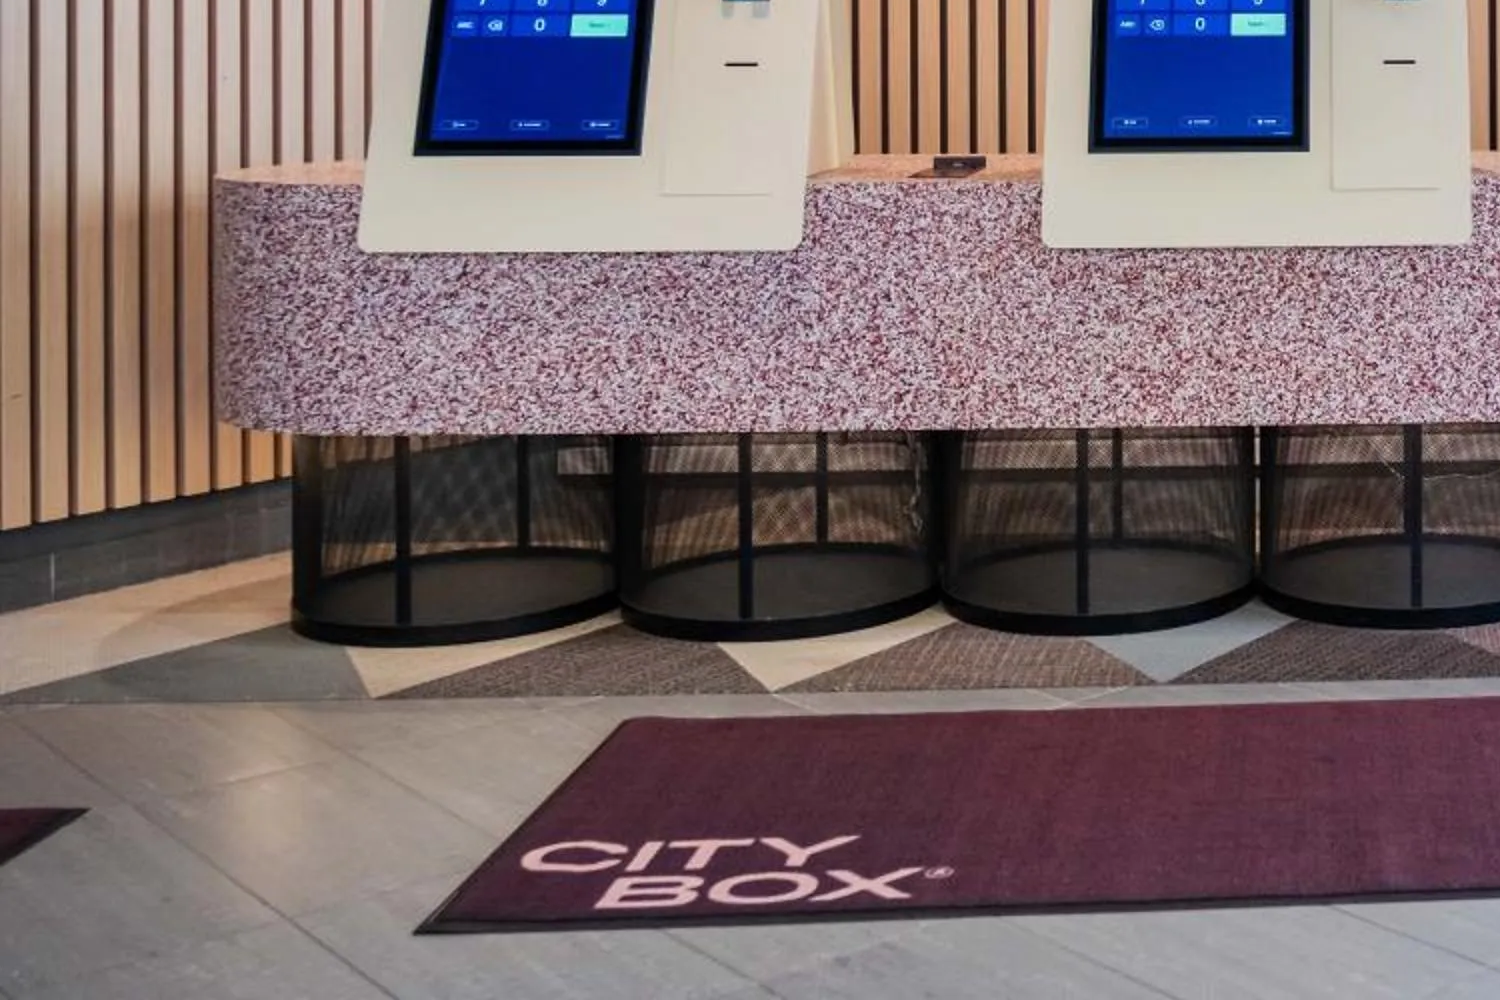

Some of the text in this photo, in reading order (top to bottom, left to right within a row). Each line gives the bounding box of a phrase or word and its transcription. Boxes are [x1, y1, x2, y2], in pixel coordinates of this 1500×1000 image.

[534, 19, 545, 31] 0
[1195, 18, 1205, 30] 0
[520, 835, 861, 873] CITY
